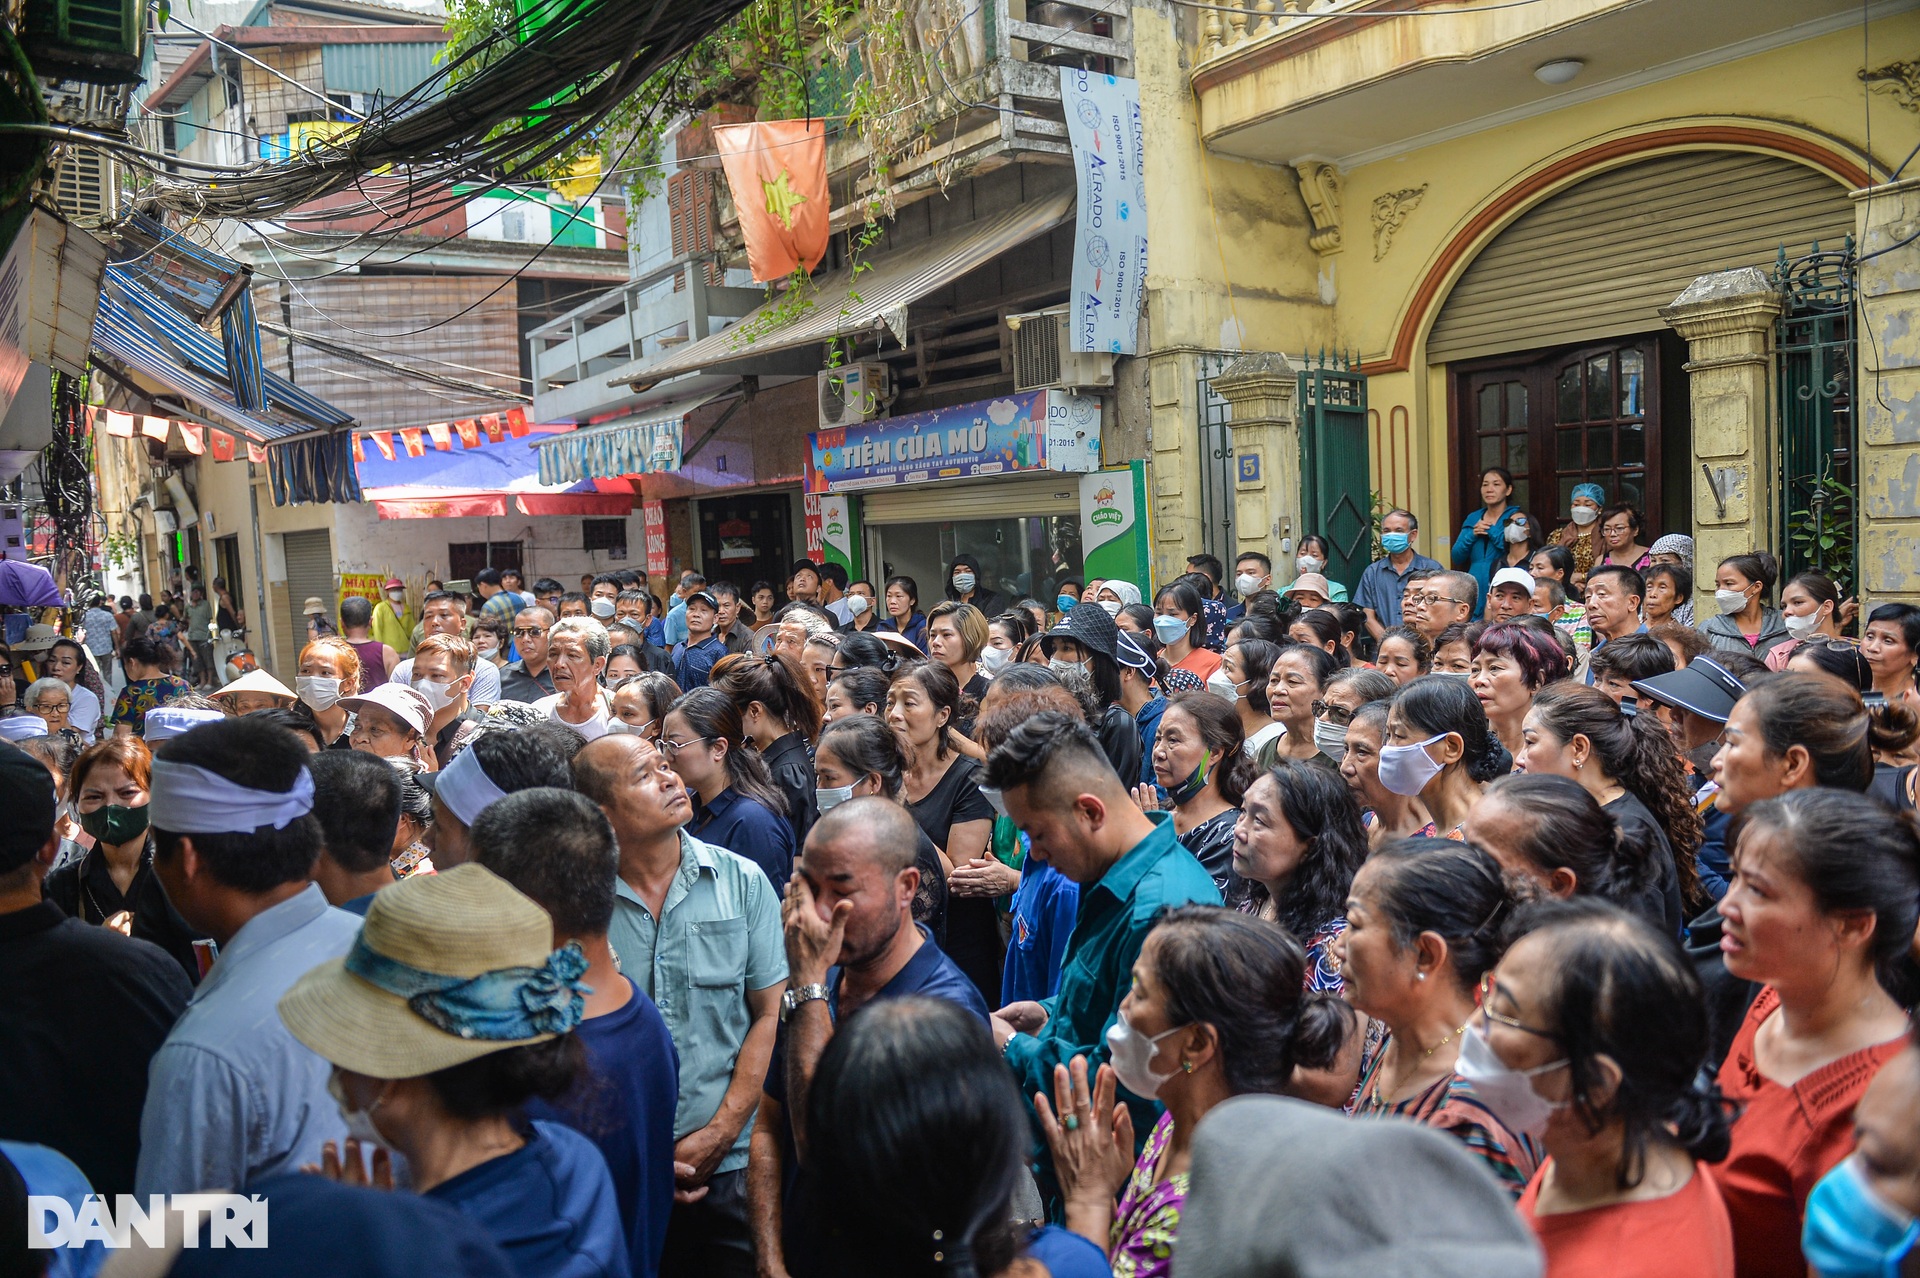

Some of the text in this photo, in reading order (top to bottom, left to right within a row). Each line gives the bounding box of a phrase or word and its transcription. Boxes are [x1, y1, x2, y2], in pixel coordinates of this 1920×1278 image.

[1112, 115, 1126, 180] ISO 9001:2015
[1089, 152, 1106, 228] ALRADO
[1113, 251, 1126, 319] ISO 9001:2015
[841, 435, 891, 475] TIỆM
[895, 424, 943, 462] CỦA
[1243, 458, 1256, 477] 5
[645, 502, 664, 526] CHÁO
[647, 529, 666, 554] LÒNG
